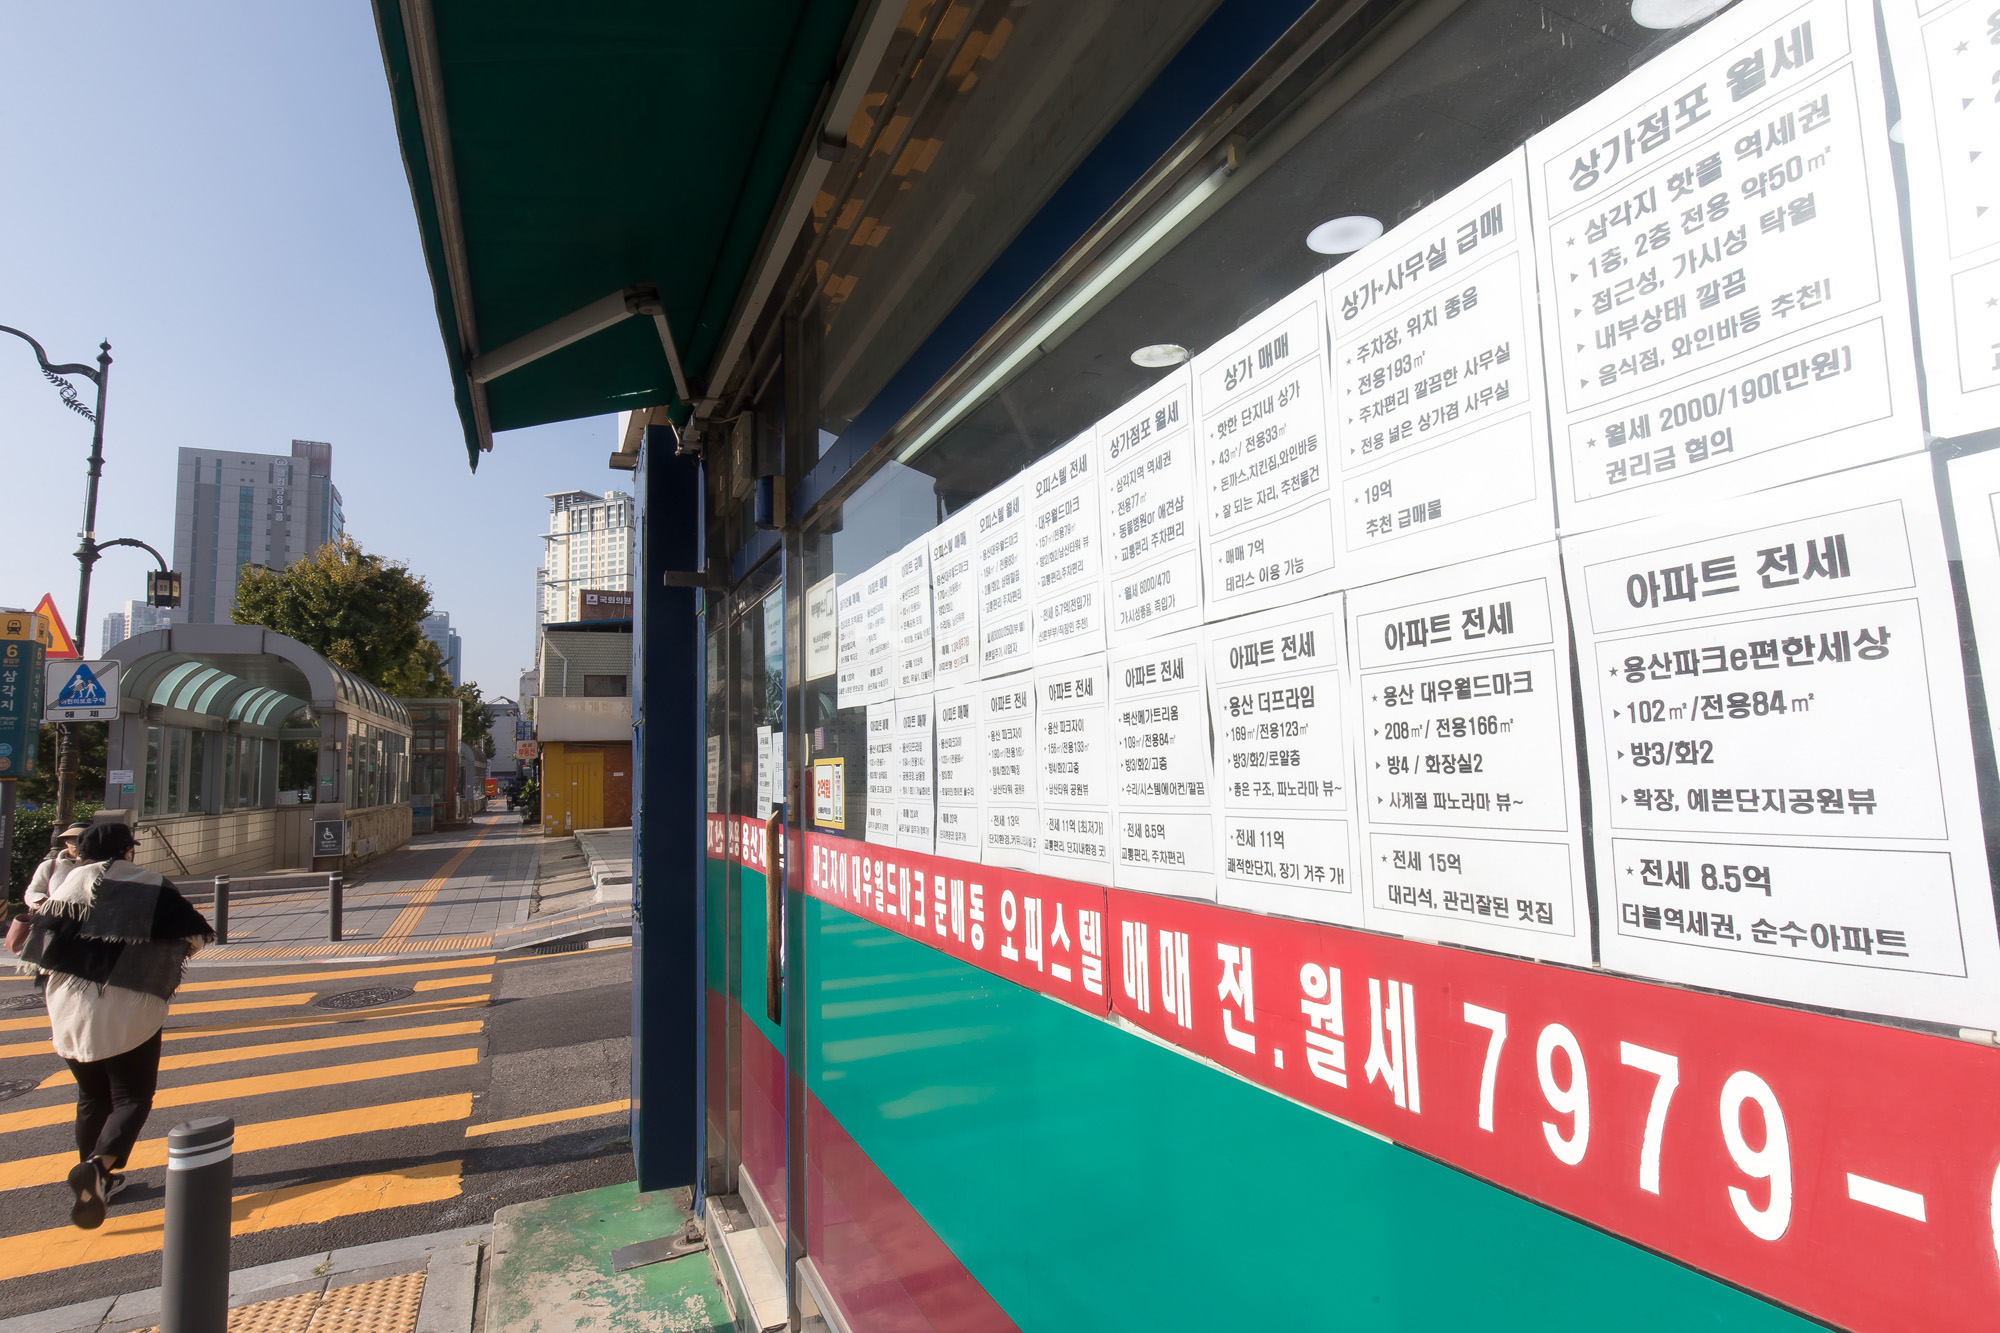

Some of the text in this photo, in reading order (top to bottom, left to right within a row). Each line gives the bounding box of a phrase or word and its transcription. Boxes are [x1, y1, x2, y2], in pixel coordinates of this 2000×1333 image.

[1569, 20, 1814, 192] 상가점포 월세
[1584, 93, 1831, 245] 삼각지 핫플 역세권
[1456, 203, 1503, 255] 급매
[1588, 192, 1730, 278] 1층, 2층 전용
[1592, 192, 1816, 316] 접근성, 가시성 탁월
[1357, 286, 1478, 364] 주차장, 위치 좋음
[1595, 268, 1746, 350] 내부상태 깔끔
[1598, 278, 1831, 387] 음식점, 와인바등 추천!
[1223, 332, 1289, 391] 상가 매매
[1359, 341, 1510, 423] 주차편리 깔끔한 사무실
[1217, 380, 1300, 440] 핫한 단지내 상가
[1361, 379, 1510, 455] 전용 넓은 상가겸 사무실
[1109, 400, 1179, 459] 상가점포 월세
[1605, 413, 1651, 448] 월세
[1116, 450, 1171, 493] 삼각지역 역세권
[1606, 427, 1734, 485] 권리금 협의
[1035, 453, 1087, 499] 오피스텔 전세
[1222, 464, 1320, 519] 잘 되는 추천물건
[1364, 479, 1392, 504] 19억
[979, 496, 1020, 533] 오피스텔 월세
[1038, 496, 1080, 530] 대우월드마크
[1366, 498, 1442, 537] 추천 급매물
[1083, 535, 1089, 548] 뷰
[1120, 521, 1184, 562] 교통편리 주차편리
[1225, 538, 1265, 564] 매매 7억
[1225, 557, 1304, 592] 테라스 이용 가능
[1626, 533, 1851, 608] 아파트 전세
[600, 595, 631, 605] 국회의원
[1124, 583, 1139, 601] 월세
[1043, 606, 1054, 622] 전세
[1384, 601, 1514, 651] 아파트 전세
[6, 644, 18, 658] 6
[1229, 630, 1315, 670] 아파트 전세
[1624, 626, 1891, 683] 용산파크e편한세상
[1, 670, 18, 711] 삼각지
[1048, 677, 1093, 701] 아파트 전세
[1125, 657, 1184, 688] 아파트 전세
[1383, 670, 1533, 707] 용산 대우월드마크
[990, 691, 1027, 712] 아파트 전세
[1122, 705, 1178, 726] 벽산메가트리움
[1229, 685, 1315, 717] 용산 더프라임
[990, 730, 1001, 742] 용산
[1047, 719, 1084, 735] 용산 파크자이
[1387, 753, 1483, 775] 방4 화장실2
[1630, 740, 1714, 767] 방3/화2
[1233, 780, 1319, 797] 좋은 구조, 파노라마
[1389, 792, 1523, 812] 사계절 파노라마 뷰~
[1633, 788, 1877, 815] 확장, 예쁜단지공원뷰
[994, 815, 1006, 827] 전세
[1049, 818, 1076, 833] 전세 11억
[1127, 823, 1165, 840] 전세 8.5억
[1236, 829, 1285, 850] 전세 11억
[1151, 850, 1185, 865] 주차편리
[1279, 862, 1325, 883] 장기 거주
[1393, 850, 1462, 875] 전세 15억
[1640, 859, 1772, 897] 전세 8.5억
[1388, 884, 1553, 925] 대리석, 관리잘된 멋집
[812, 844, 848, 898] 파크자이
[851, 851, 926, 928] 대우월드마크
[934, 875, 985, 952] 문배동
[1000, 889, 1103, 996] 오피스텔
[1121, 920, 1192, 1031] 매매
[1622, 903, 1909, 957] 더블역세권, 순수아파트
